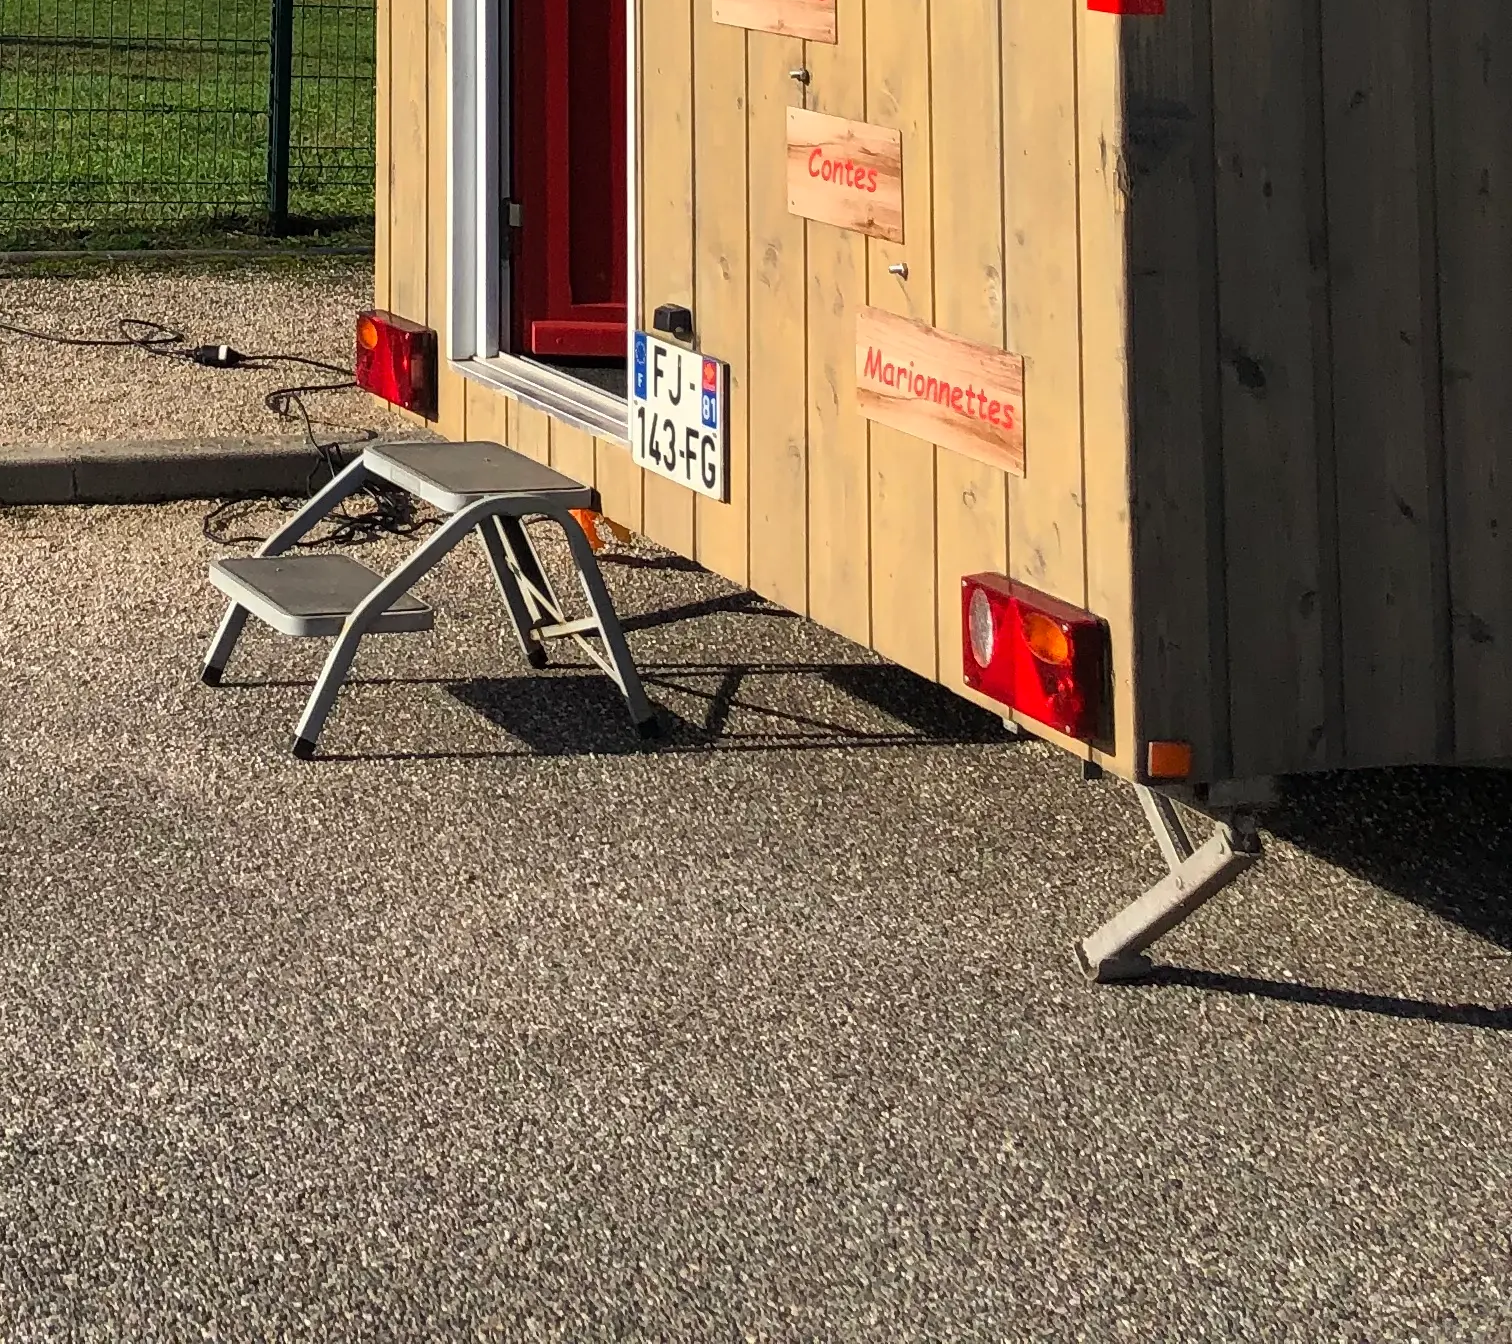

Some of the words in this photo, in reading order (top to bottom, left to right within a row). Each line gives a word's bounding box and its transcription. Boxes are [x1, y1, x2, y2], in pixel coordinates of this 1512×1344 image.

[808, 148, 878, 193] Contes
[702, 395, 717, 423] 81
[863, 345, 1016, 431] Marionnettes
[637, 406, 717, 490] 143-FG
